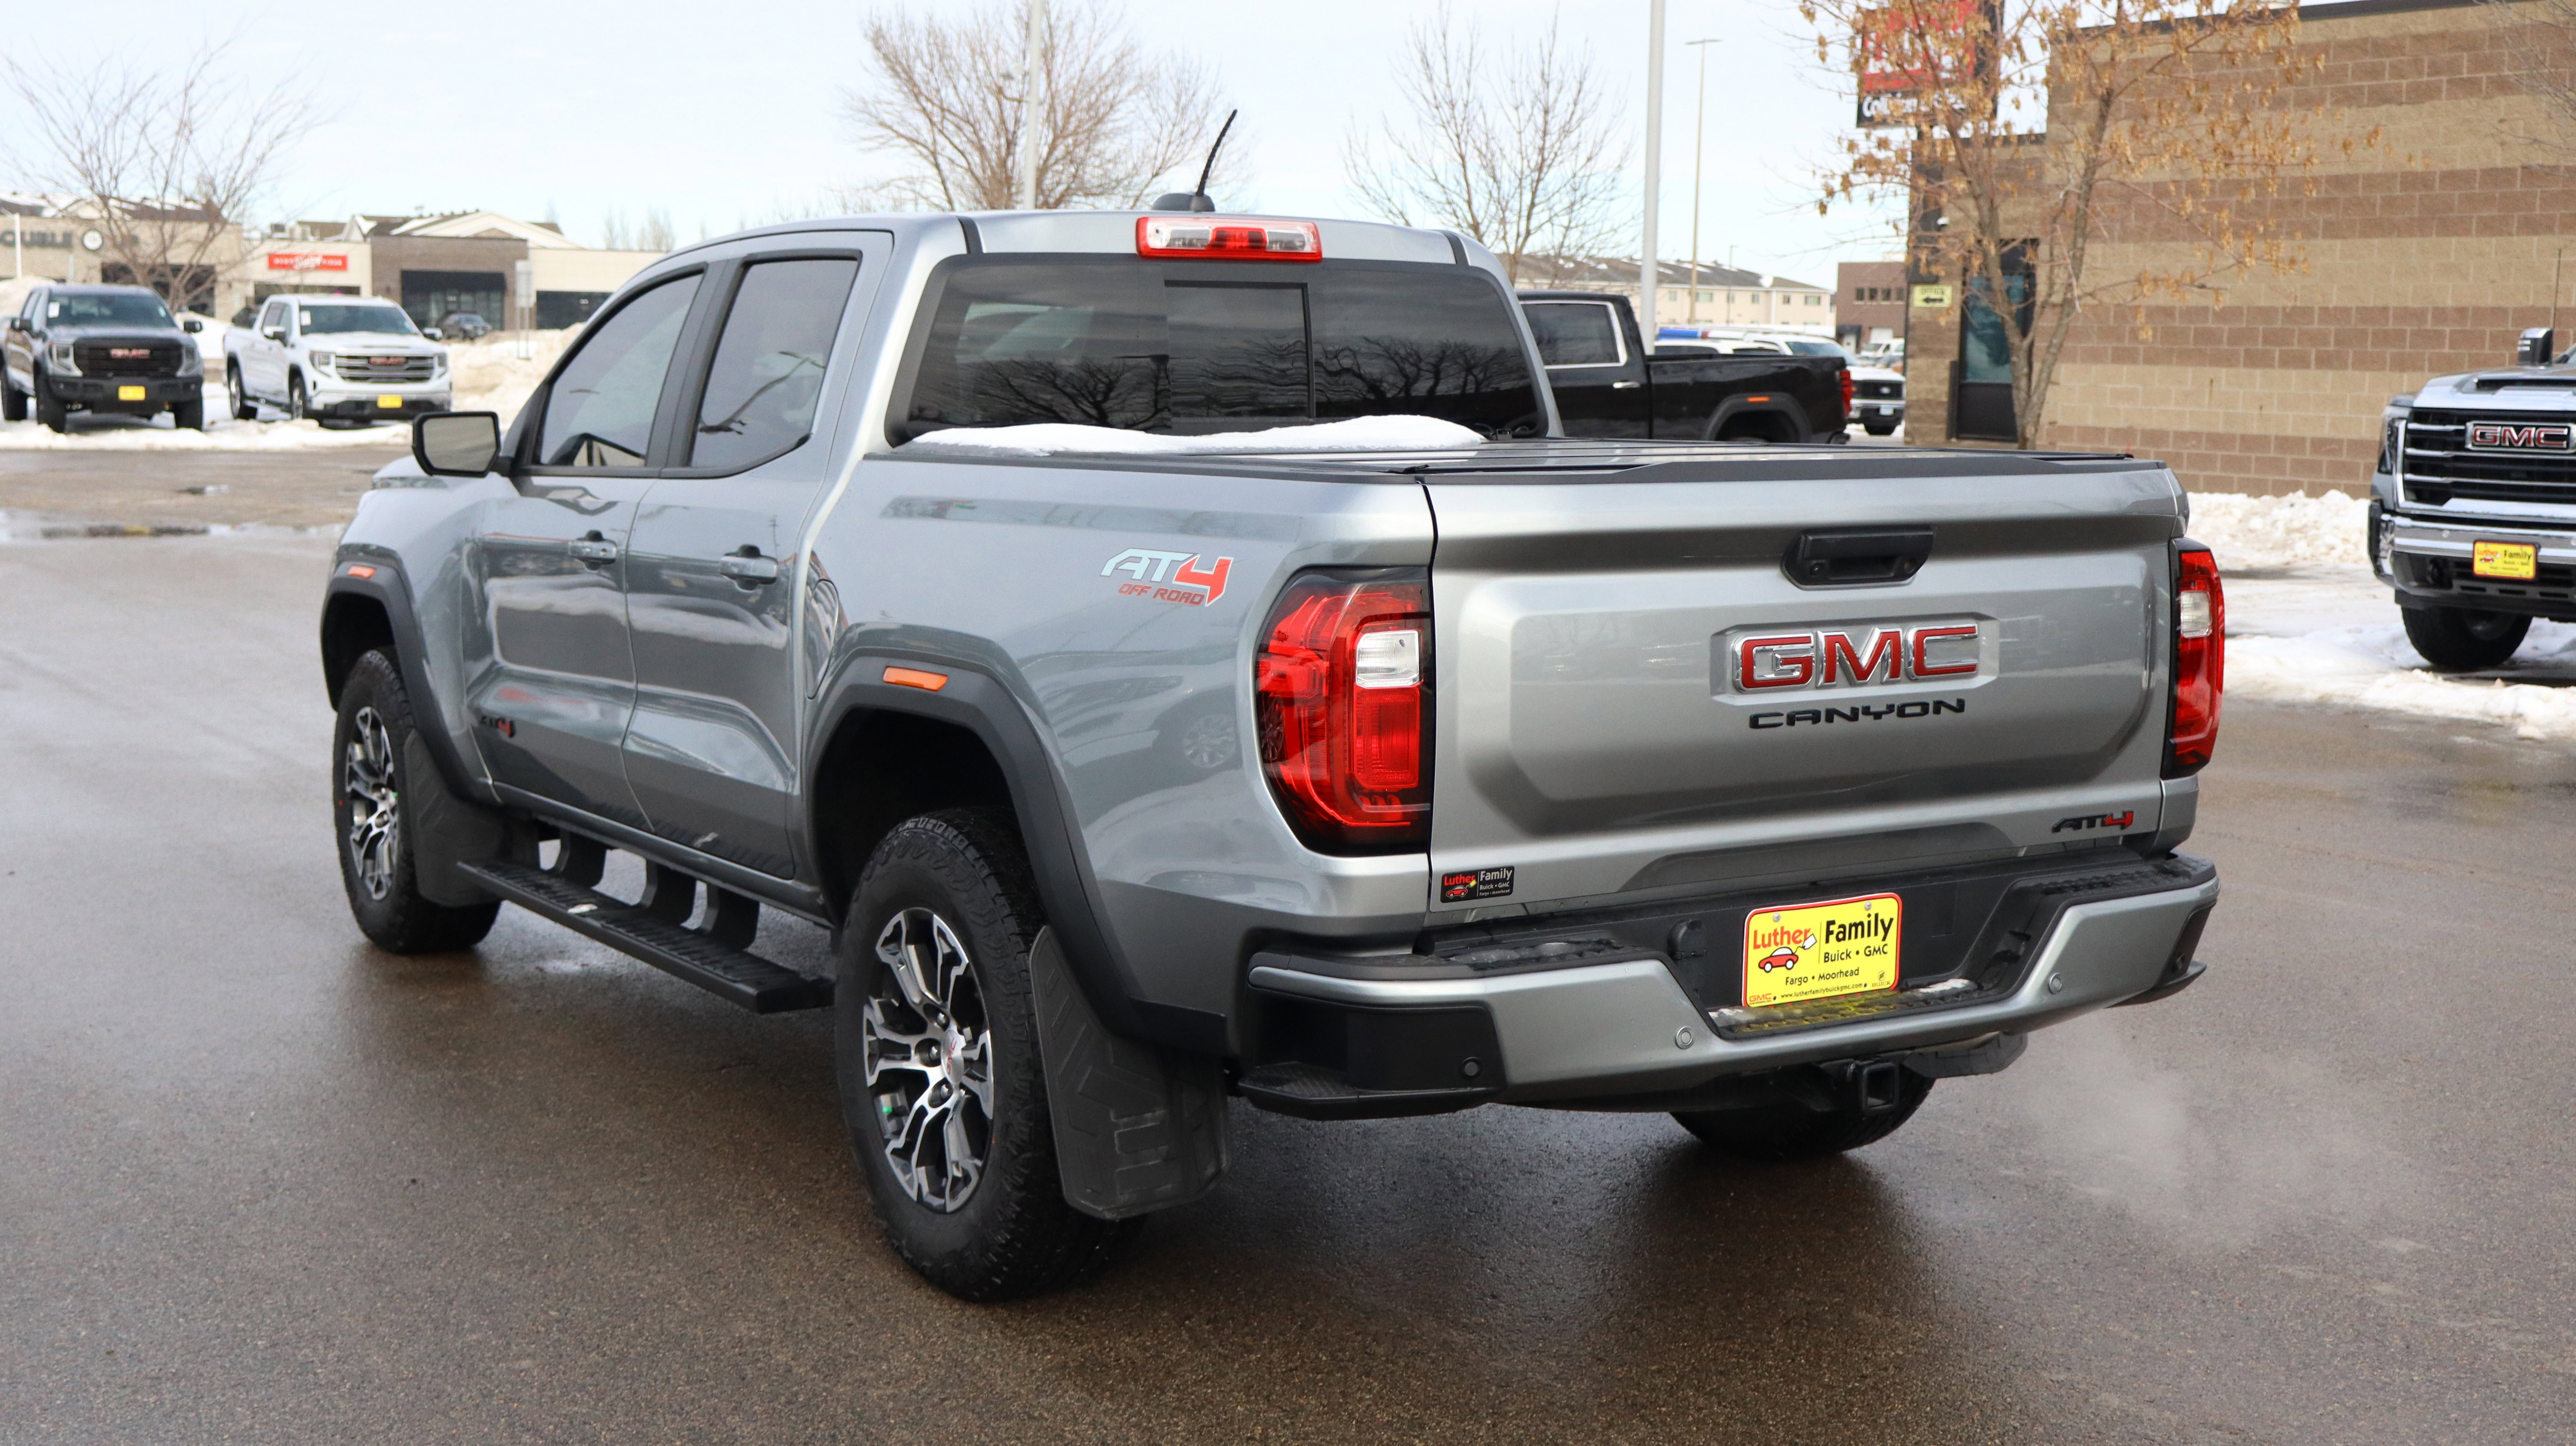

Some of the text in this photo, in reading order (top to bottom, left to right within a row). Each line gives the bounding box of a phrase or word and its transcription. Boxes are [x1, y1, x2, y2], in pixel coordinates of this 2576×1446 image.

[2473, 426, 2568, 448] GMC
[2504, 550, 2531, 560] Family
[1100, 547, 1234, 607] AT4
[1118, 583, 1206, 606] OFF ROAD
[1733, 623, 1978, 694] GMC
[1750, 697, 1966, 729] CANYON
[2052, 810, 2134, 833] AT4
[1444, 868, 1513, 886] Luther Family
[1753, 912, 1894, 950] Luther Family
[1824, 943, 1888, 963] Buick GMC
[1786, 967, 1859, 986] Fargo Moorhead
[1749, 993, 1772, 1002] GMC
[1781, 983, 1863, 999] www.lutherfamilybuickgmc.com
